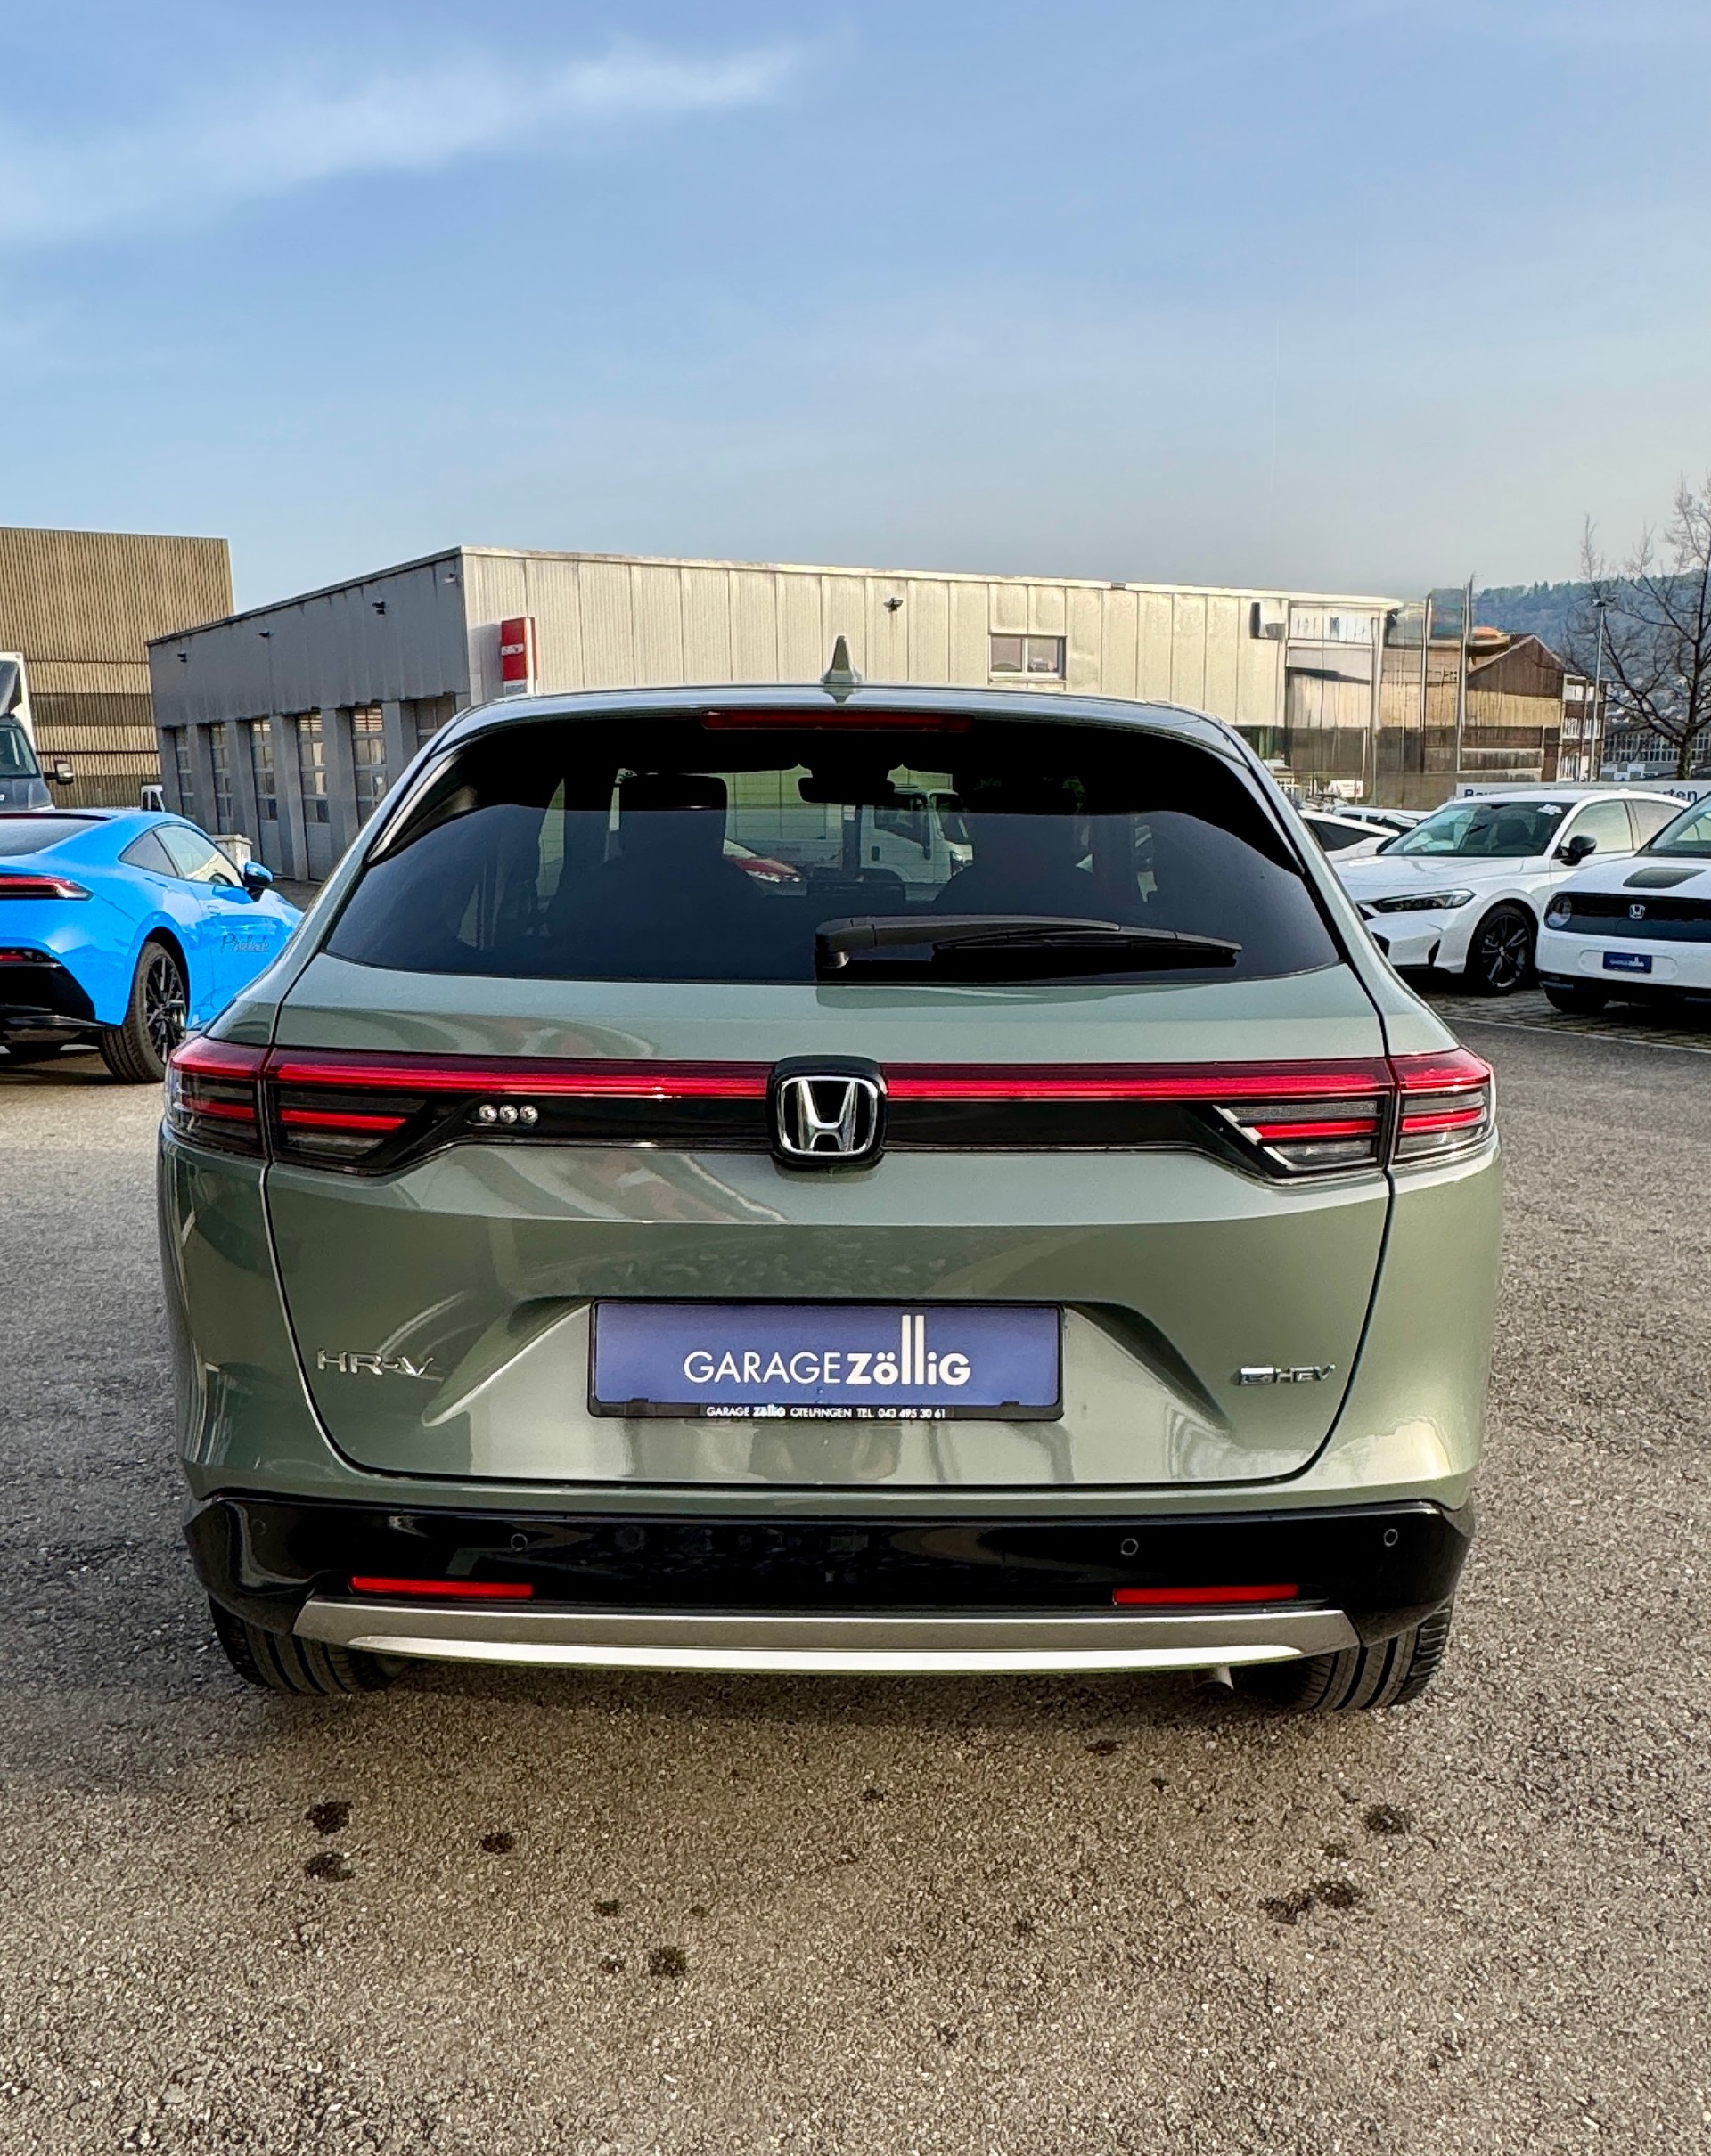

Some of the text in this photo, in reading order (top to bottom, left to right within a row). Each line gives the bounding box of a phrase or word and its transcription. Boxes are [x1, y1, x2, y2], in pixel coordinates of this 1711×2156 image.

[317, 1349, 434, 1377] HR-V
[684, 1351, 842, 1384] GARAGE
[706, 1406, 750, 1417] GARAGE
[790, 1407, 853, 1418] OTELFINGEN
[898, 1408, 918, 1419] 495
[919, 1408, 933, 1419] 30
[934, 1409, 946, 1419] 61
